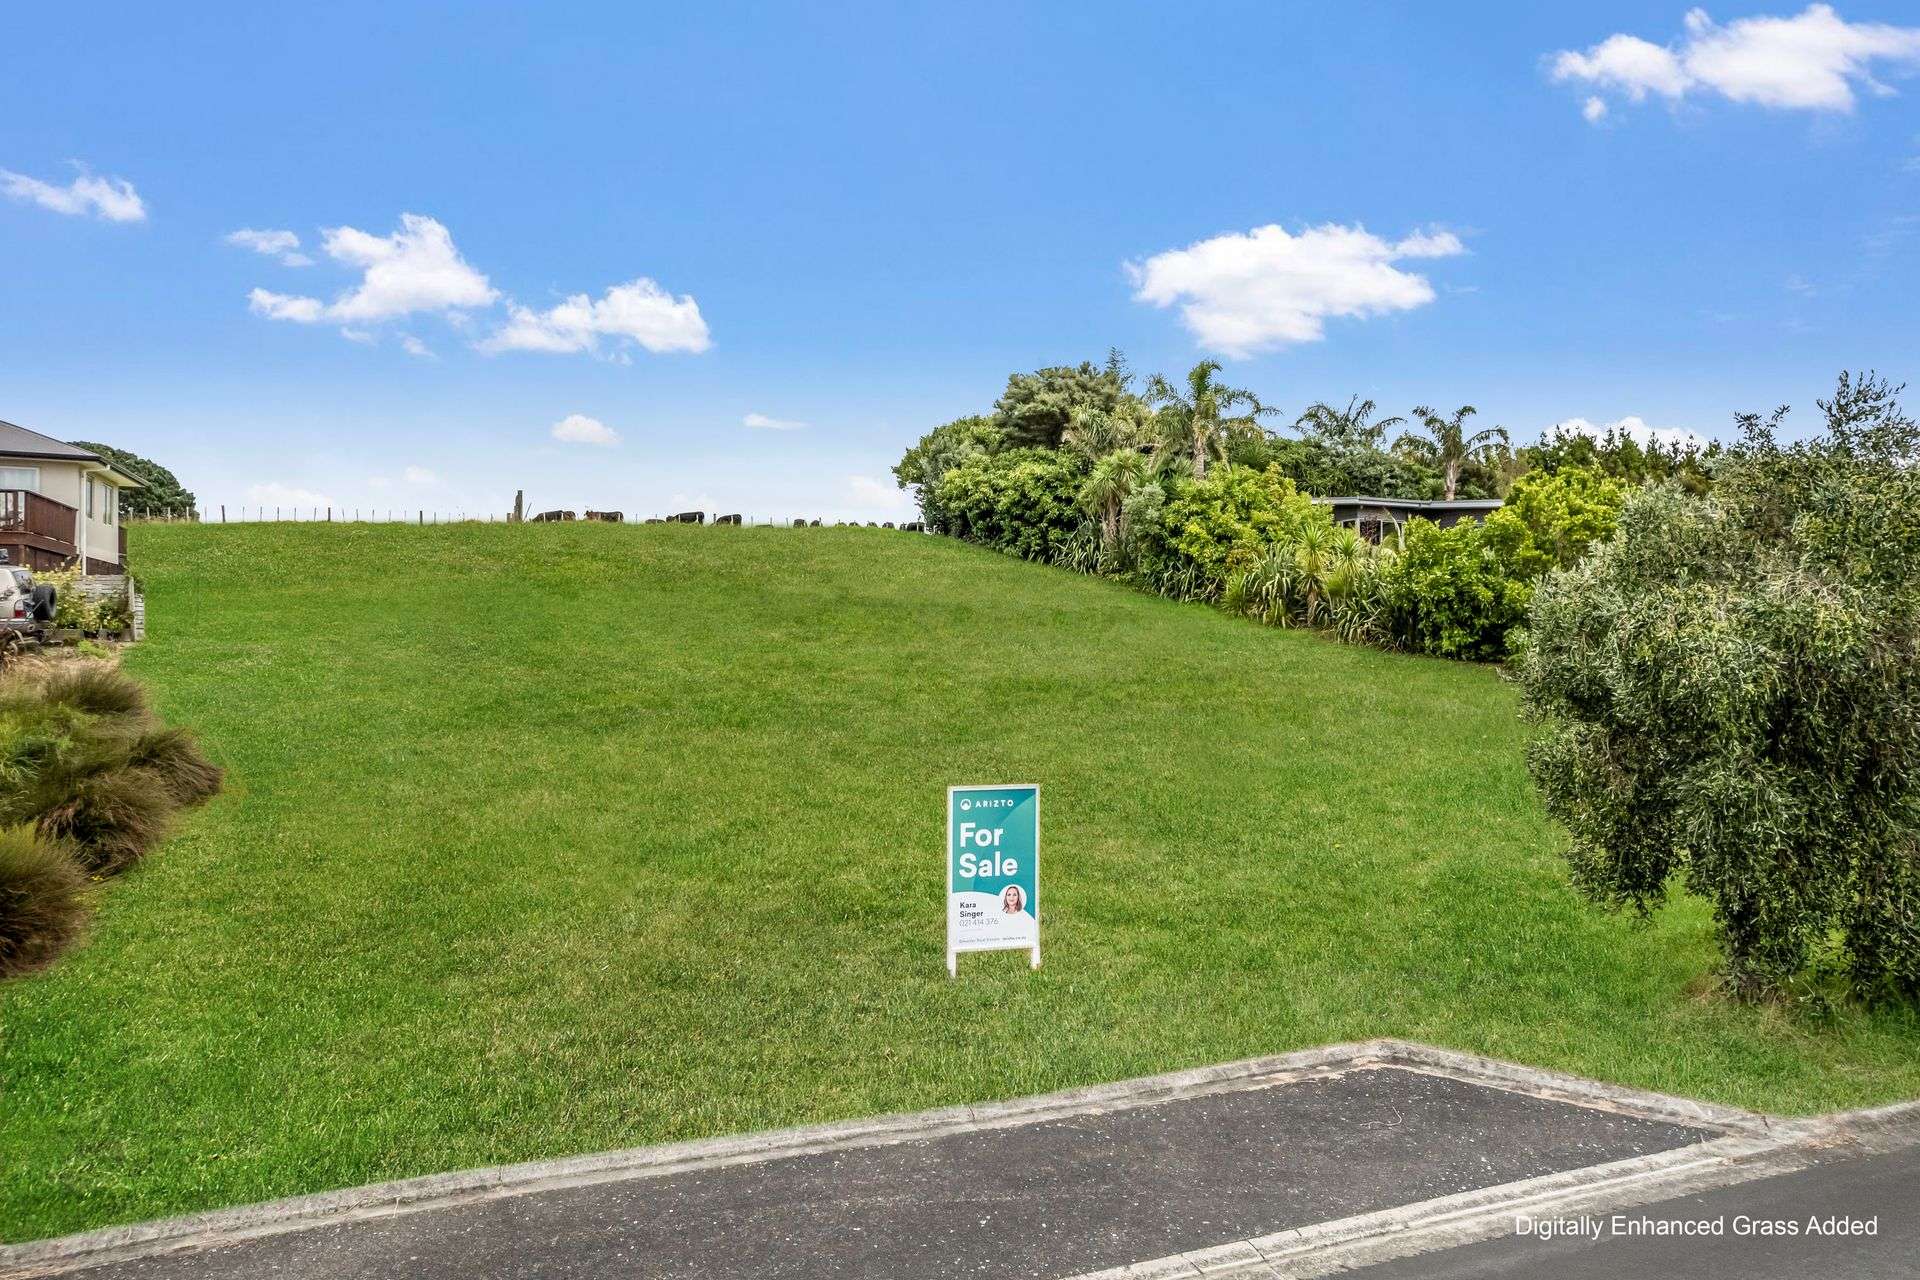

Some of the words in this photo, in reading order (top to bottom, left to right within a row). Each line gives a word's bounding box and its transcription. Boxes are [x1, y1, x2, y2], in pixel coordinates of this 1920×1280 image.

[975, 799, 1014, 808] ARIZTO
[960, 822, 1004, 848] For
[959, 851, 1018, 878] Sale
[960, 910, 983, 919] Singer
